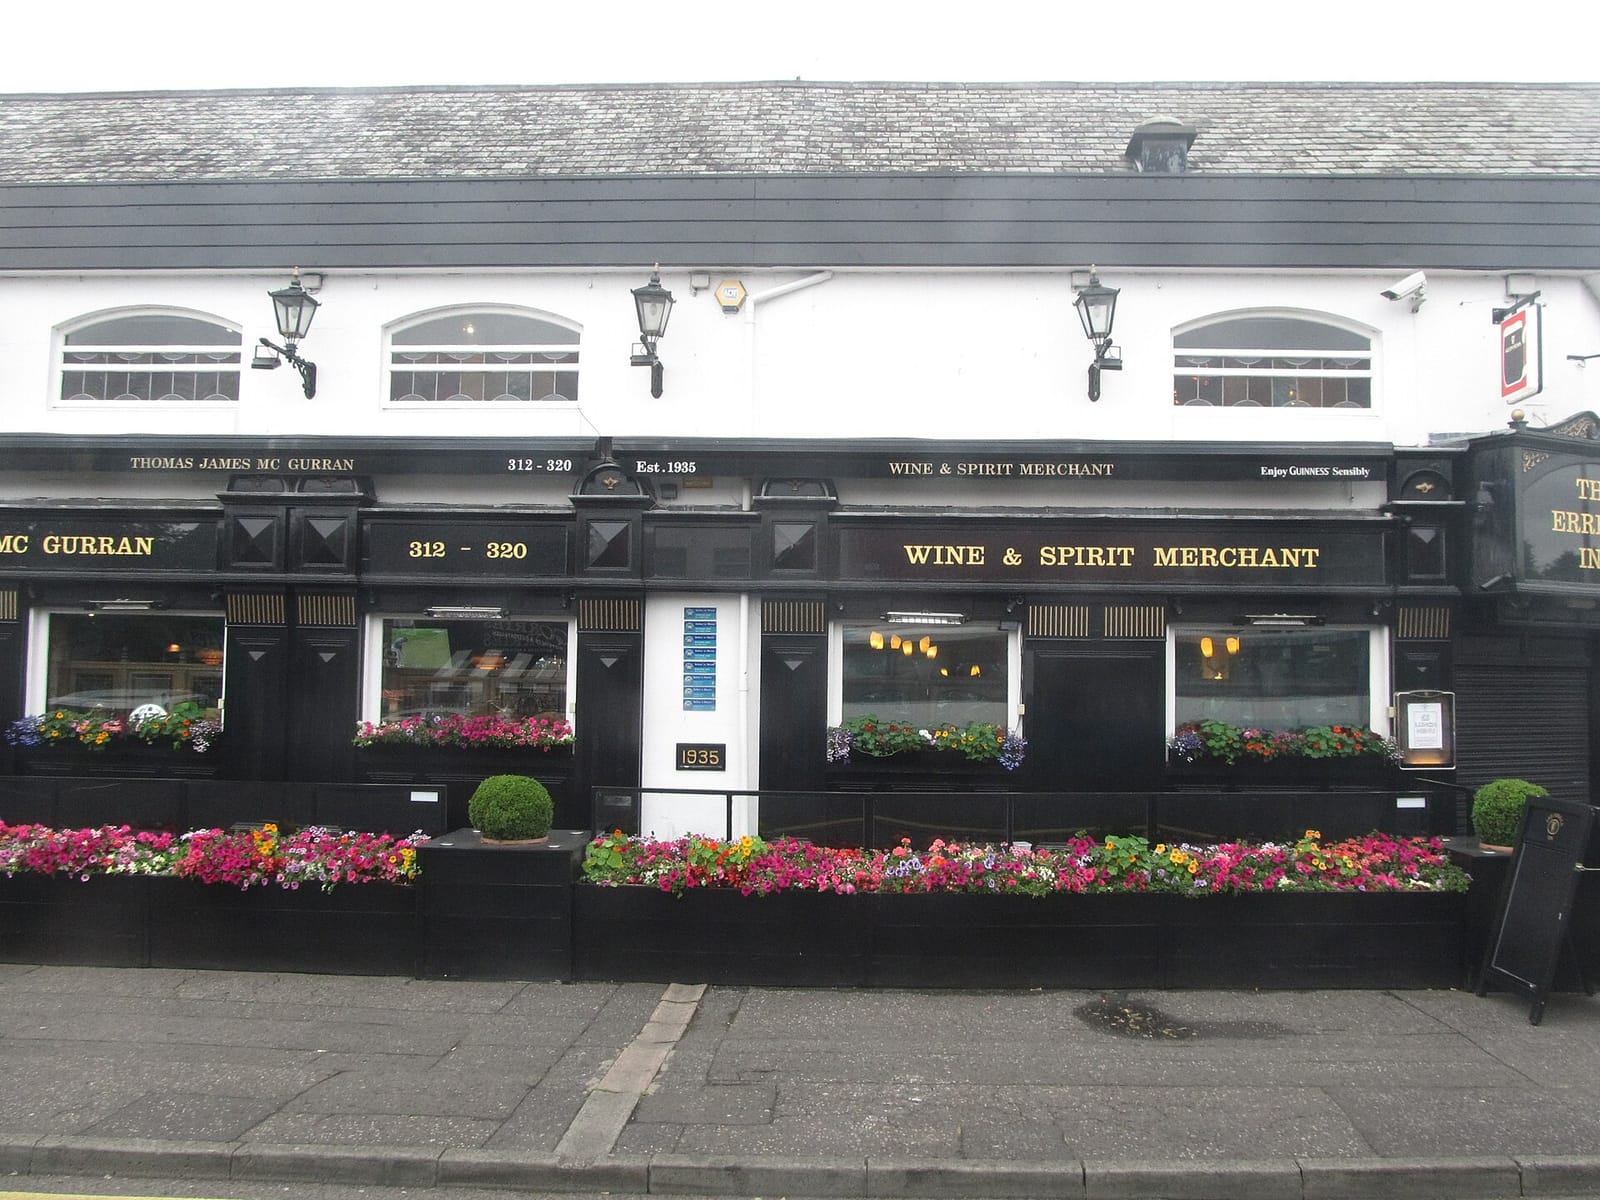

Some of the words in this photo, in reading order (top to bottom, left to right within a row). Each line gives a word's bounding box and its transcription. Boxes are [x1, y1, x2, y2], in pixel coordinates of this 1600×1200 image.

[130, 457, 194, 469] THOMAS
[199, 457, 251, 470] JAMES
[256, 458, 280, 470] MC
[287, 458, 355, 471] GURRAN
[507, 458, 533, 471] 312
[546, 459, 572, 472] 320
[888, 462, 933, 475] WINE
[939, 462, 952, 475] &
[956, 462, 1014, 476] SPIRIT
[1019, 463, 1114, 476] MERCHANT
[1260, 466, 1289, 478] Enjoy
[1288, 465, 1331, 476] GUINNESS
[1332, 466, 1370, 478] Sensibly
[42, 535, 155, 556] GURRAN
[409, 541, 446, 558] 312
[486, 542, 528, 559] 320
[903, 545, 985, 565] WINE
[1002, 547, 1022, 566] &
[1040, 546, 1135, 567] SPIRIT
[1153, 547, 1320, 568] MERCHANT
[682, 749, 720, 765] 1935
